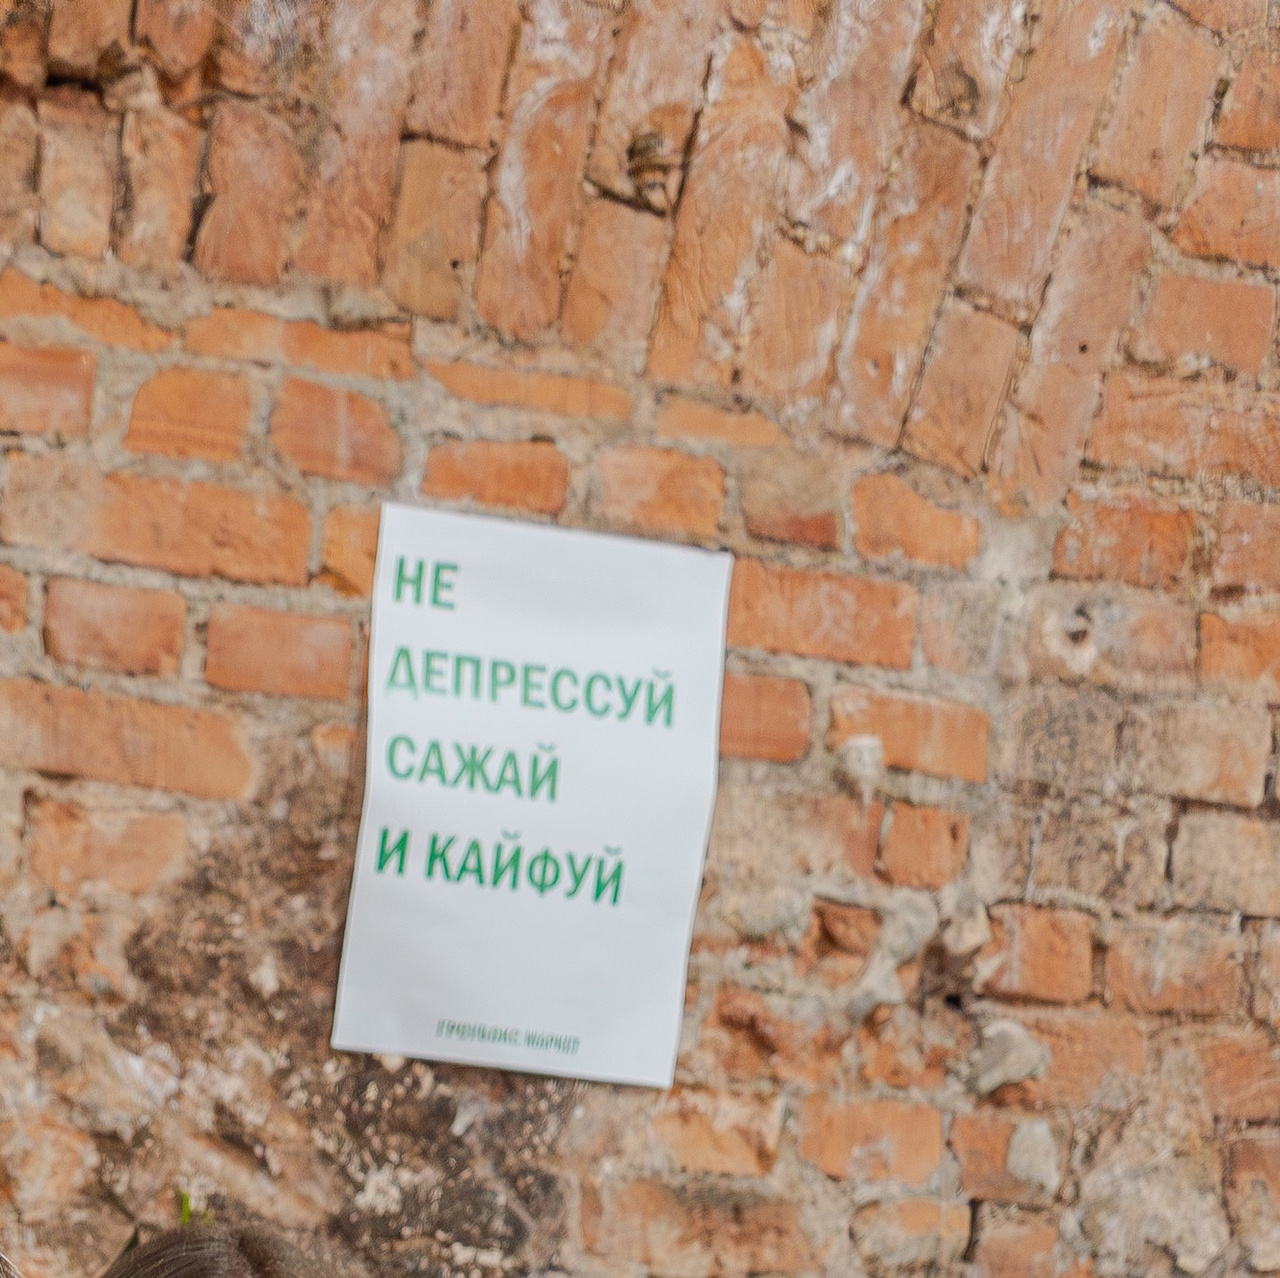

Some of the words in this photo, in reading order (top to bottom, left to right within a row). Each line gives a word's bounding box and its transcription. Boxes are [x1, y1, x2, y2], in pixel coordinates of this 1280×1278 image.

[393, 555, 458, 610] НЕ
[384, 646, 676, 727] ДЕПРЕССУЙ
[385, 735, 560, 804] САЖАЙ
[376, 826, 409, 876] И
[425, 829, 624, 906] КАЙФУЙ
